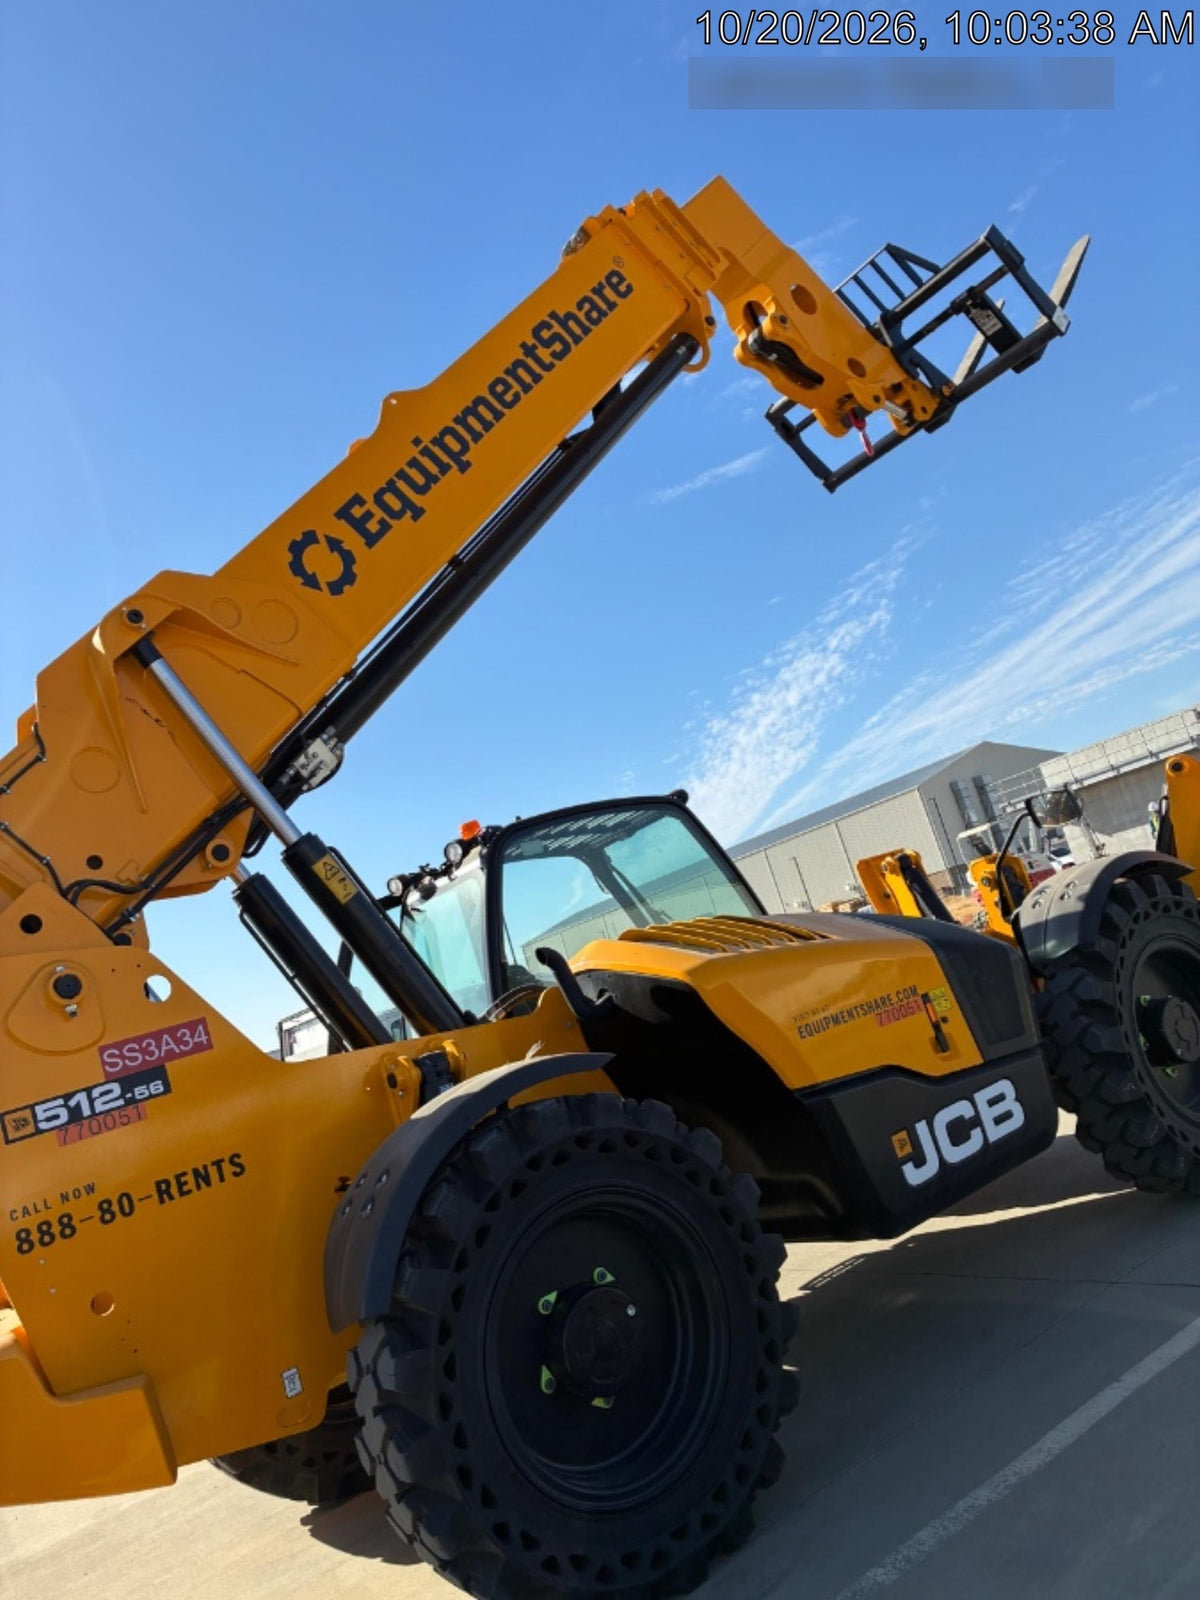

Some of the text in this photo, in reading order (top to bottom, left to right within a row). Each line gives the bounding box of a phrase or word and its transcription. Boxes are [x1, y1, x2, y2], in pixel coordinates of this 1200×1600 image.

[333, 268, 634, 550] EquipmentShare
[797, 985, 920, 1039] EQUIPMENTSHARE.COM
[102, 1023, 209, 1073] SS3A34
[58, 1105, 144, 1145] 770051
[901, 1078, 1025, 1187] JCB
[9, 1182, 97, 1222] CALL NOW
[15, 1153, 247, 1255] 888-80-RENTS
